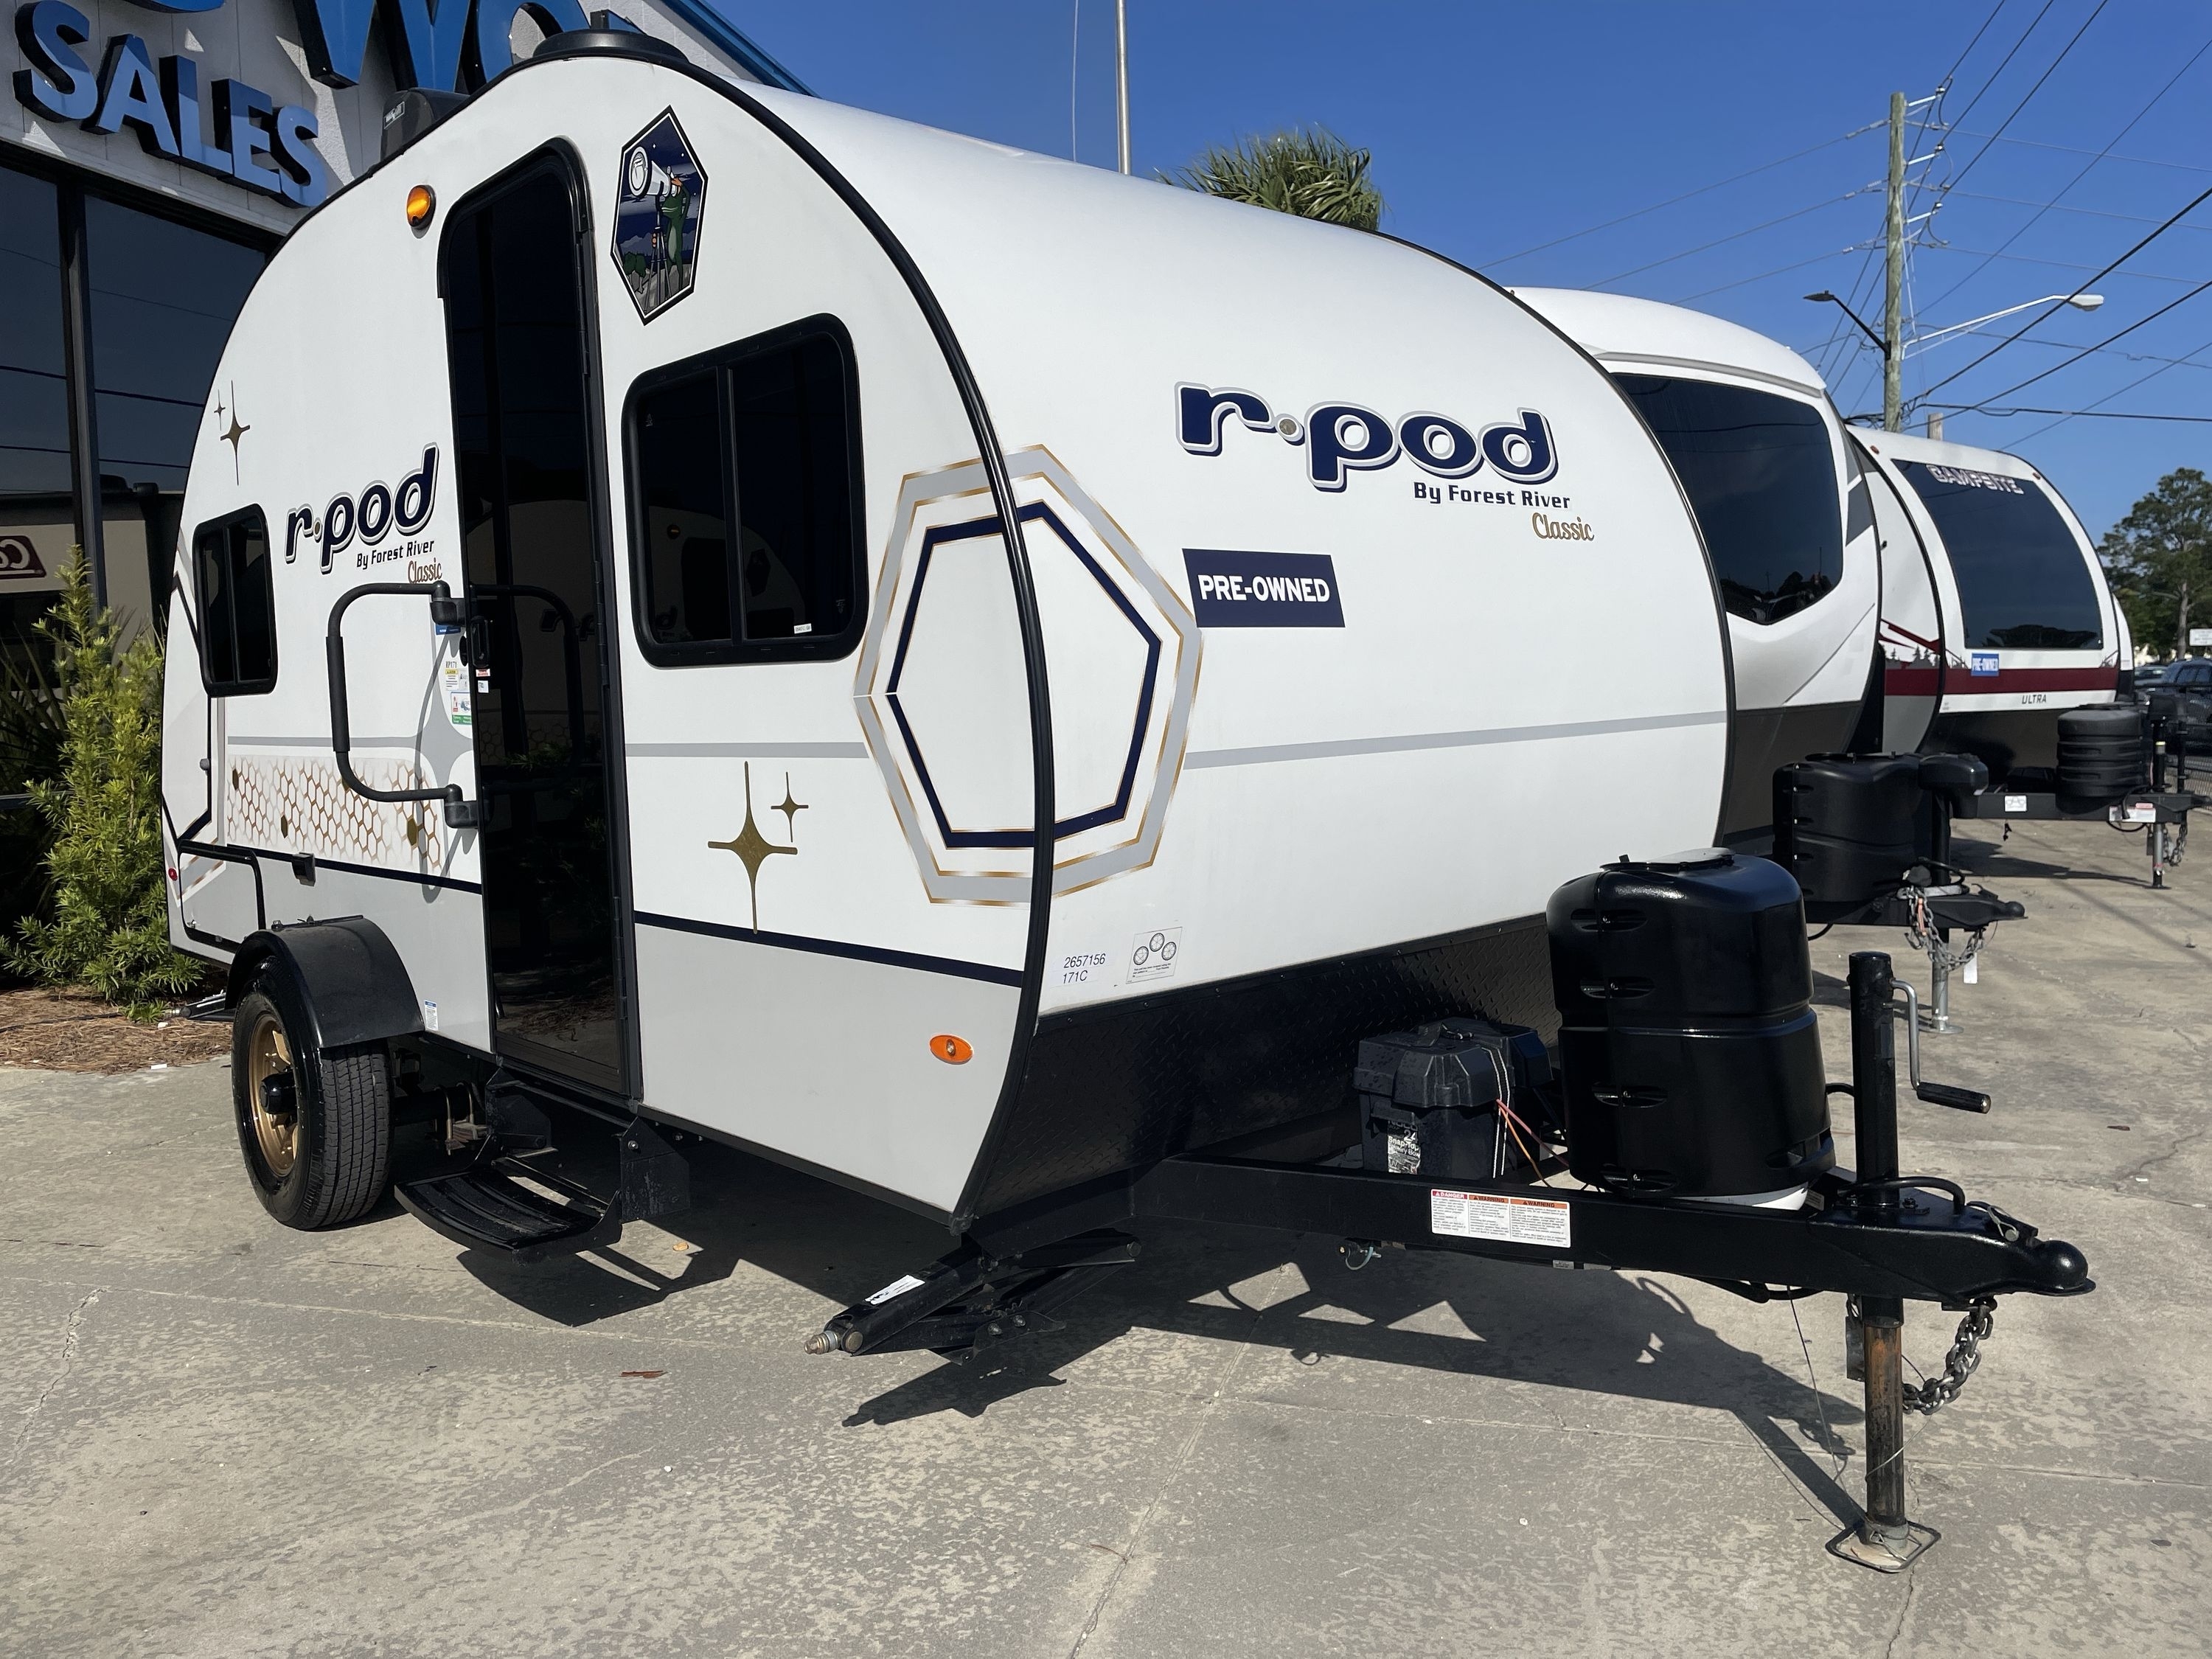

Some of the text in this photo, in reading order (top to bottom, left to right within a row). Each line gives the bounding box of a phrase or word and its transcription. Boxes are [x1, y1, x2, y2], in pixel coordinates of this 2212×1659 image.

[13, 0, 327, 207] SALES
[1413, 481, 1571, 509] By Forest River
[1531, 512, 1595, 541] Classic
[357, 540, 435, 570] By Forest River
[408, 557, 442, 584] Classic
[1197, 574, 1330, 602] PRE-OWNED
[2022, 694, 2047, 705] ULTRA
[1064, 953, 1106, 968] 2657156
[1063, 970, 1088, 984] 171C
[1440, 1192, 1465, 1200] DANGER
[1478, 1195, 1505, 1203] WARNING
